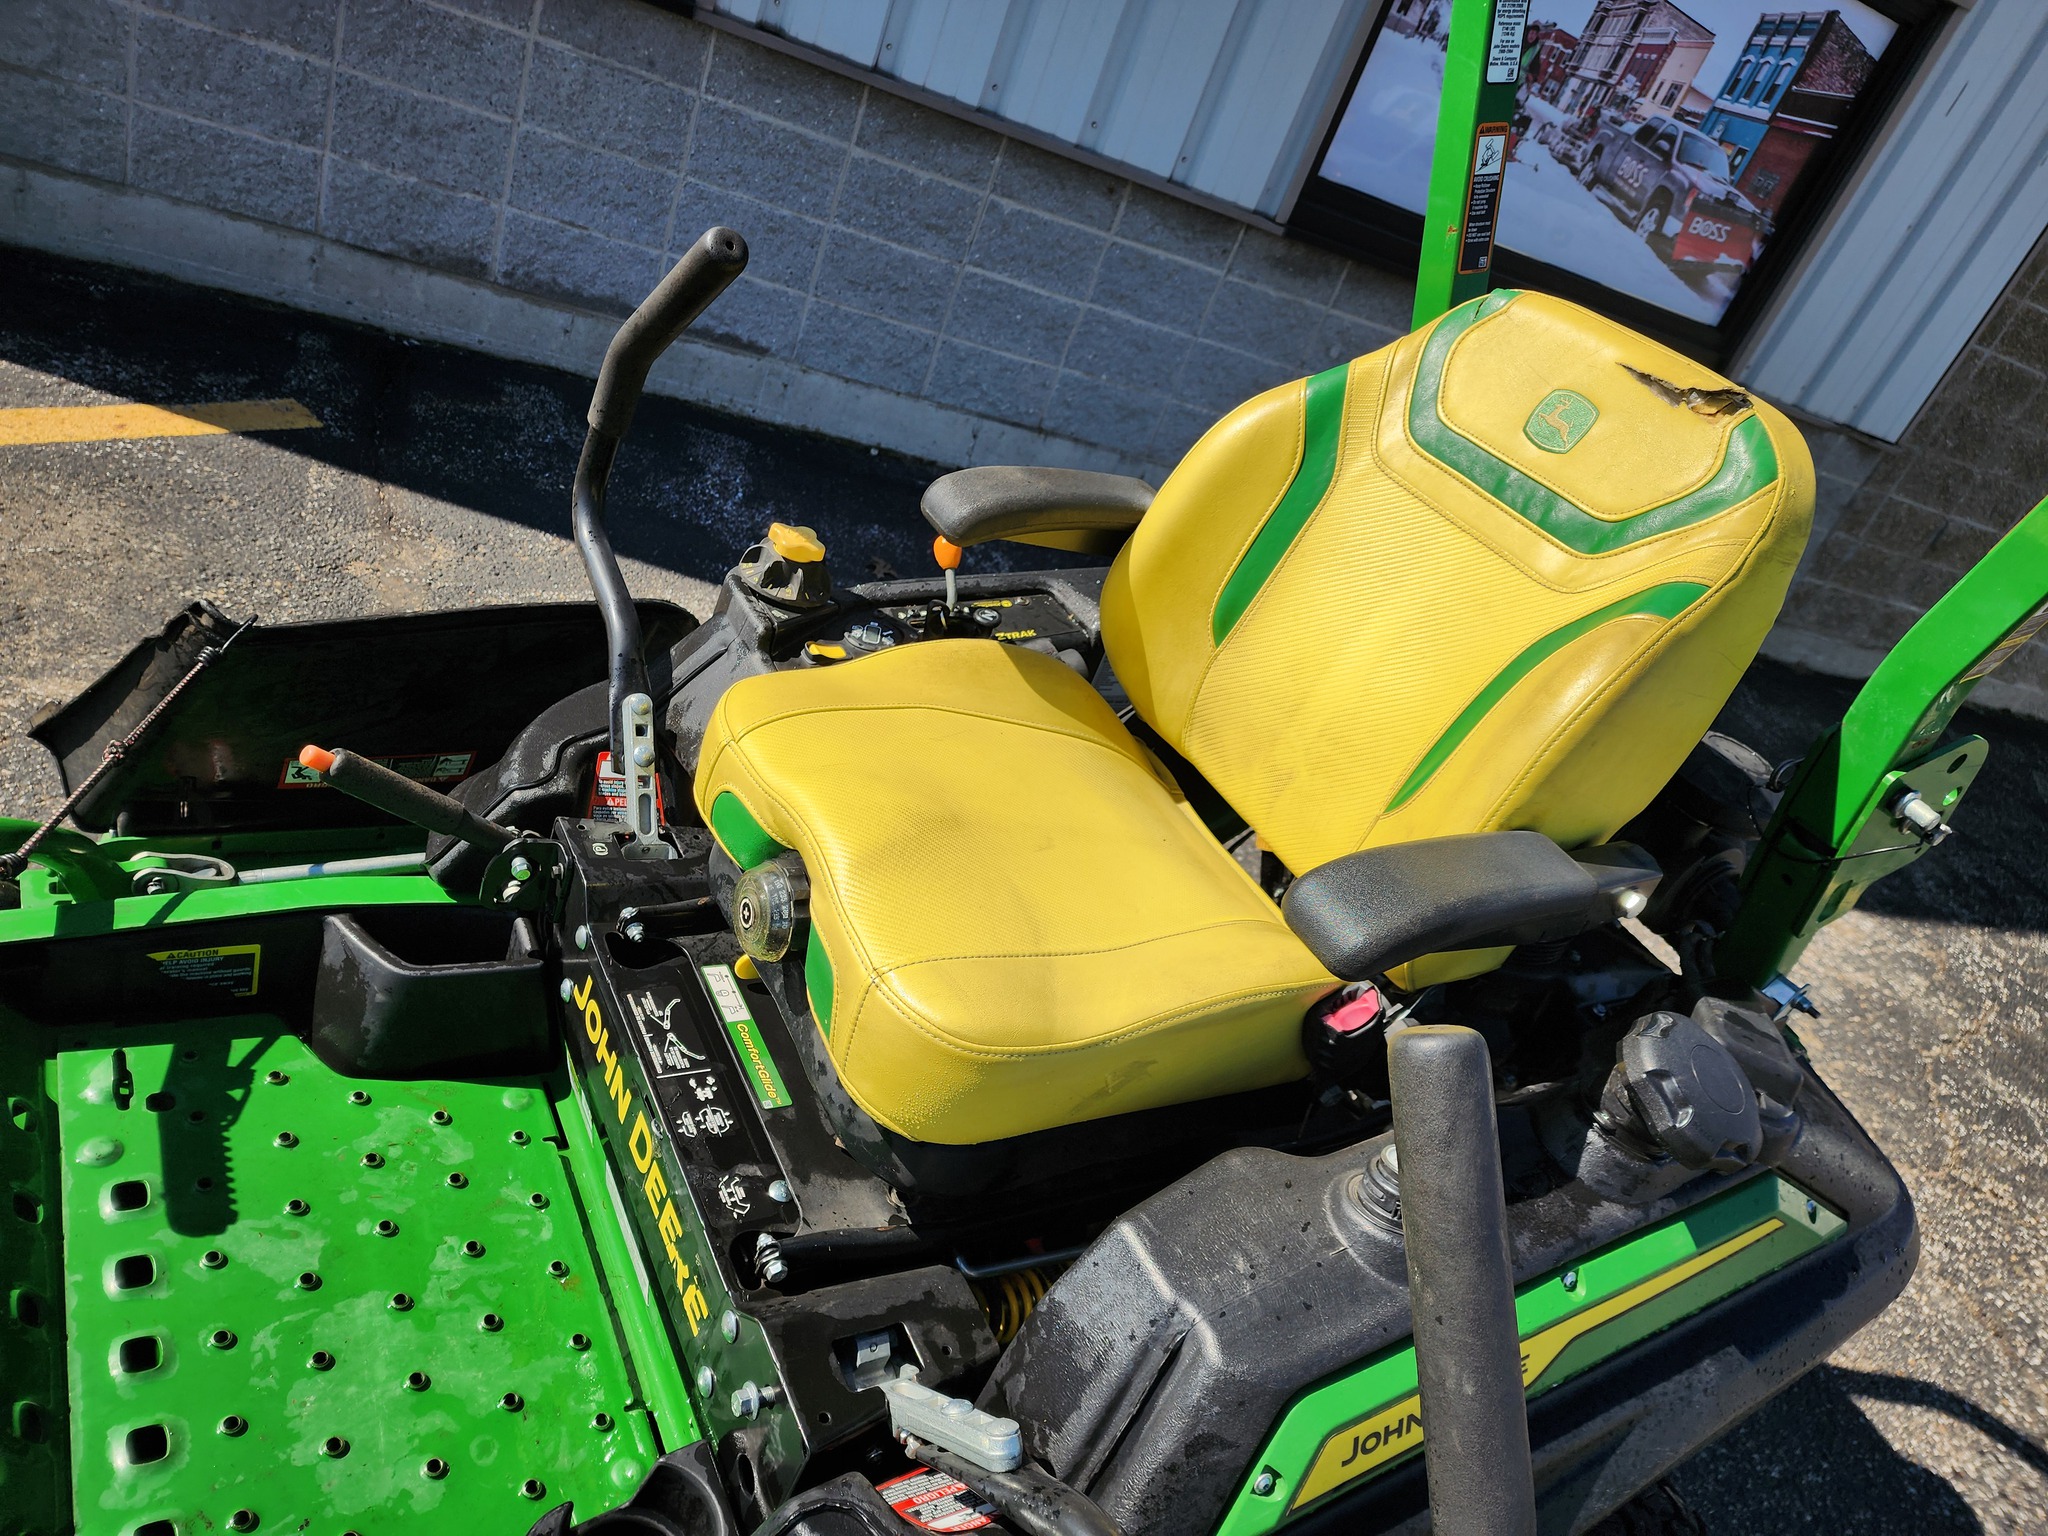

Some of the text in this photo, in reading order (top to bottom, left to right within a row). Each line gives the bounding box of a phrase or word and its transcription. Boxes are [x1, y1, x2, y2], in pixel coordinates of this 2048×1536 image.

[1617, 156, 1649, 188] BOSS
[1689, 217, 1731, 243] BOSS
[995, 629, 1037, 641] ZTRAK
[177, 949, 219, 960] CAUTION
[574, 977, 632, 1122] JOHN
[628, 1114, 710, 1336] DEERE
[1341, 1413, 1423, 1467] JOHN
[913, 1486, 957, 1504] PELIGRO
